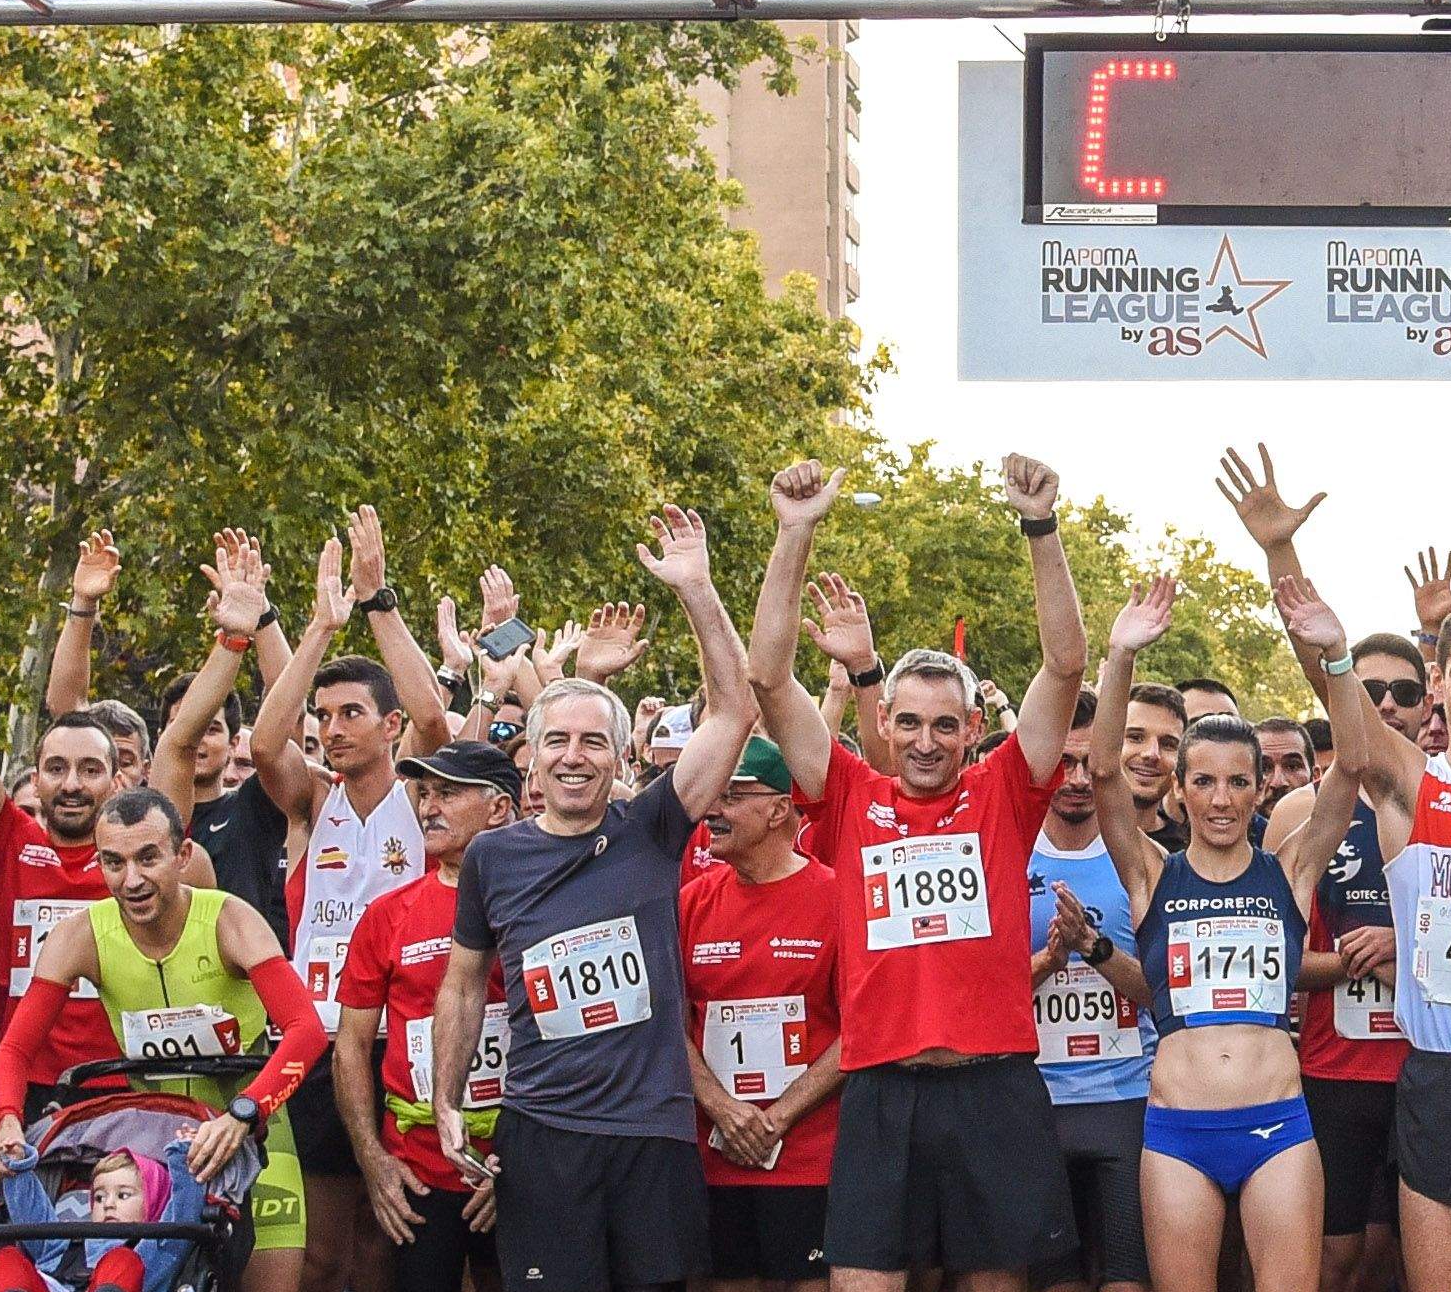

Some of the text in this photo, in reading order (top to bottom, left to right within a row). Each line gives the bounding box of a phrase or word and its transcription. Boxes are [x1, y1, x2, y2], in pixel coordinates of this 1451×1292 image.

[1042, 267, 1200, 293] RUNNING
[1042, 294, 1201, 323] LEAGUE
[1121, 325, 1203, 357] by as
[1405, 326, 1429, 344] by
[873, 884, 885, 908] 10K
[894, 866, 979, 909] 1889
[1164, 895, 1278, 914] CORPOREPOL
[1419, 913, 1431, 934] 460
[1173, 954, 1185, 977] 10K
[1197, 944, 1281, 981] 1715
[558, 950, 641, 1001] 1810
[534, 979, 550, 1003] 10K
[1033, 989, 1115, 1025] 10059
[411, 1034, 423, 1054] 255
[730, 1030, 744, 1066] 1
[789, 1032, 801, 1056] 10K
